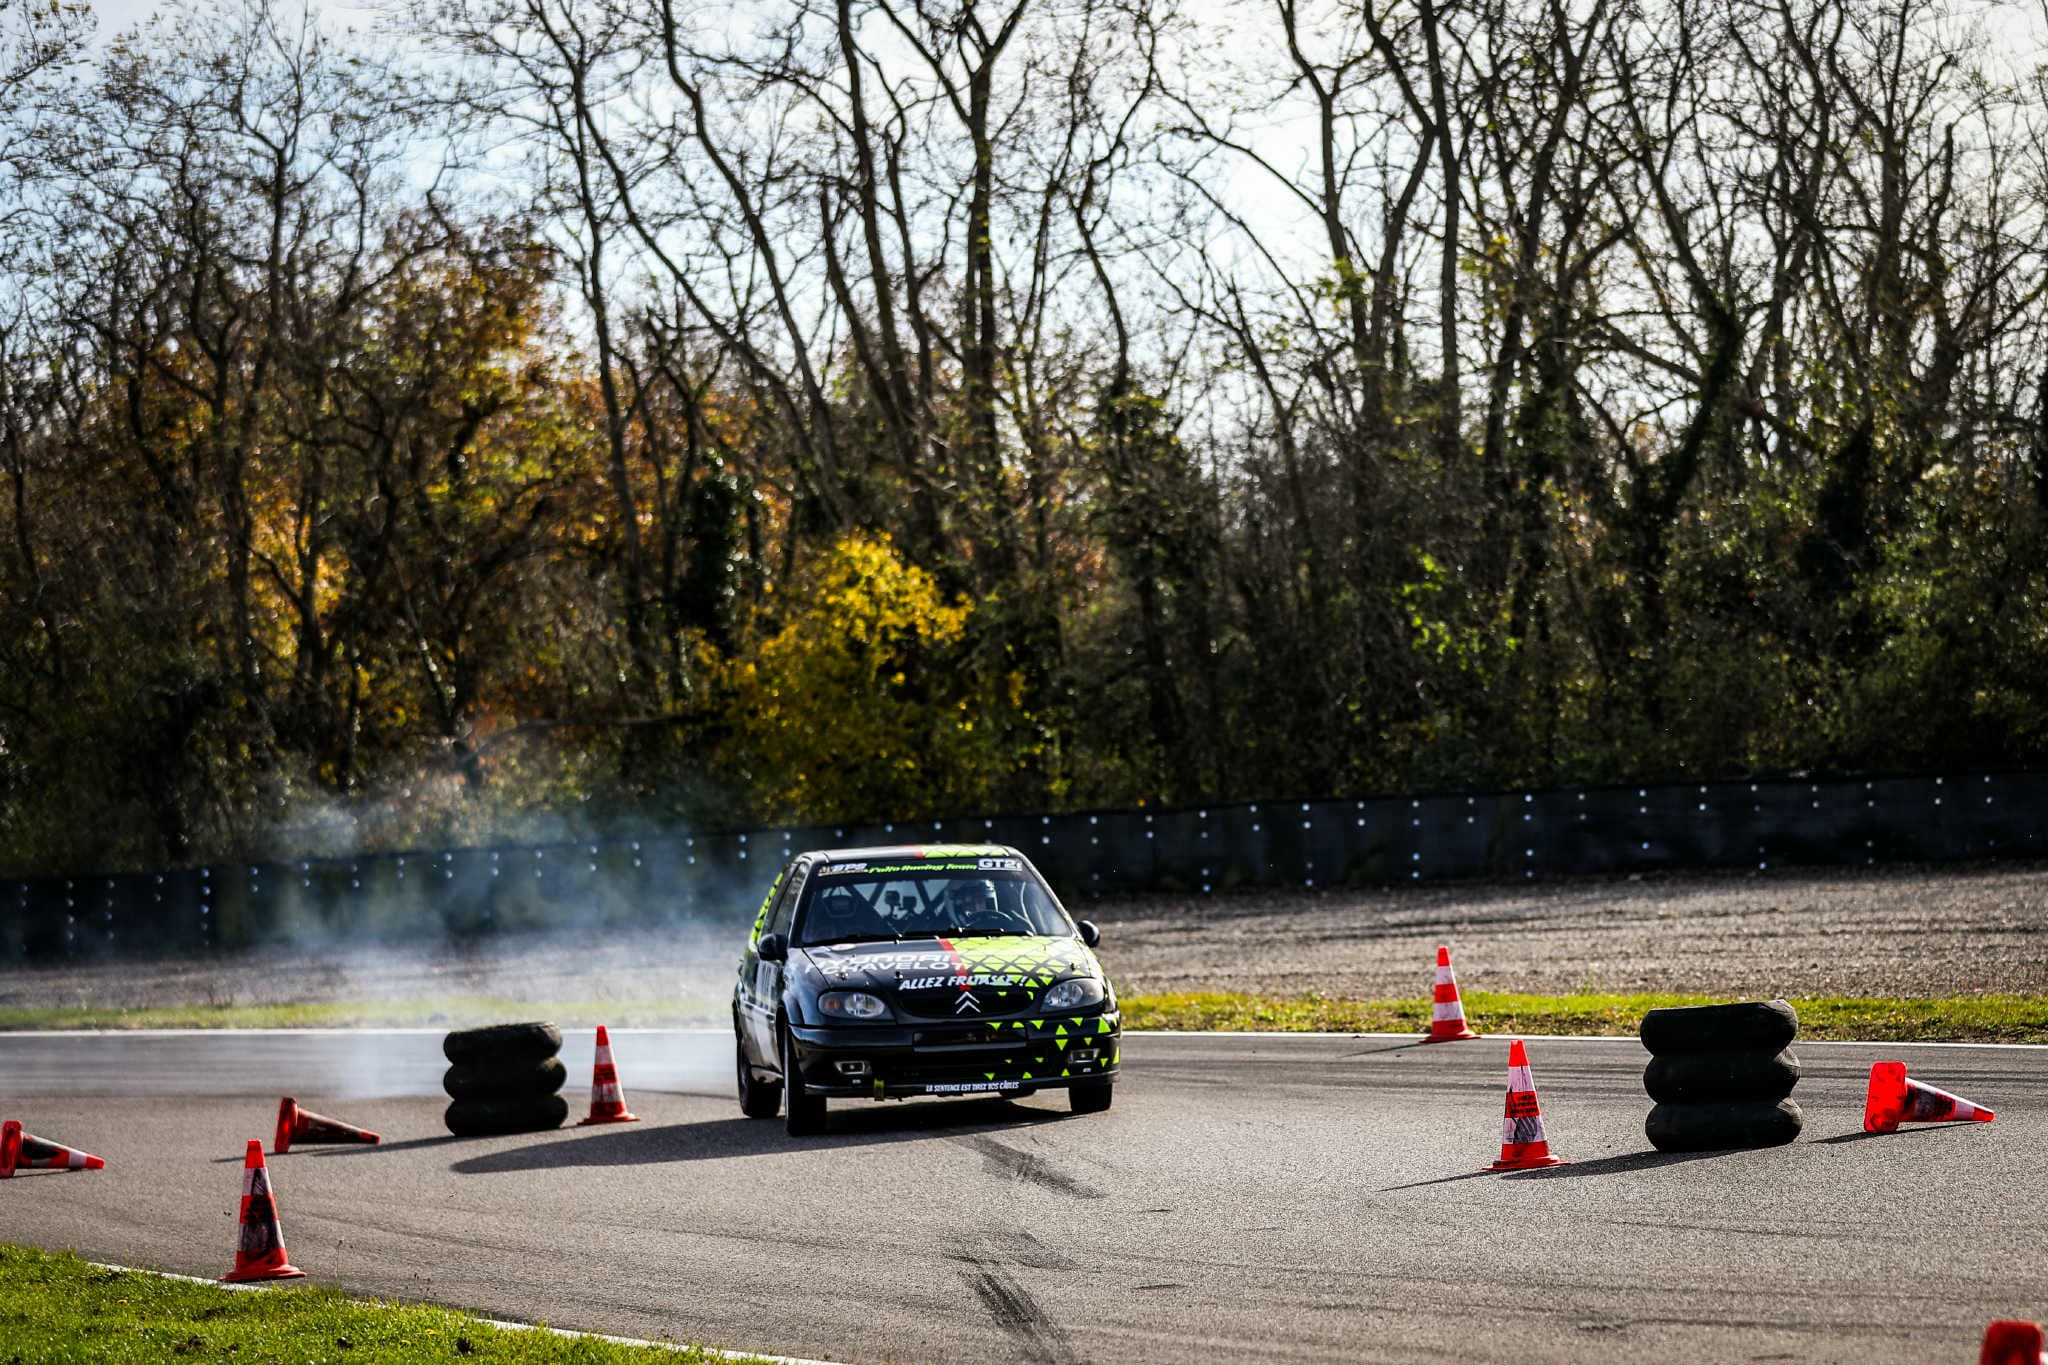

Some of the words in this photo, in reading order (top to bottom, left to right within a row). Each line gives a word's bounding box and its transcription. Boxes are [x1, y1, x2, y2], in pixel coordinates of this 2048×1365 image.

[821, 962, 963, 975] CHAVELOT
[899, 976, 945, 990] ALLEZ
[934, 1084, 960, 1092] SENTENCE
[961, 1083, 971, 1091] EST
